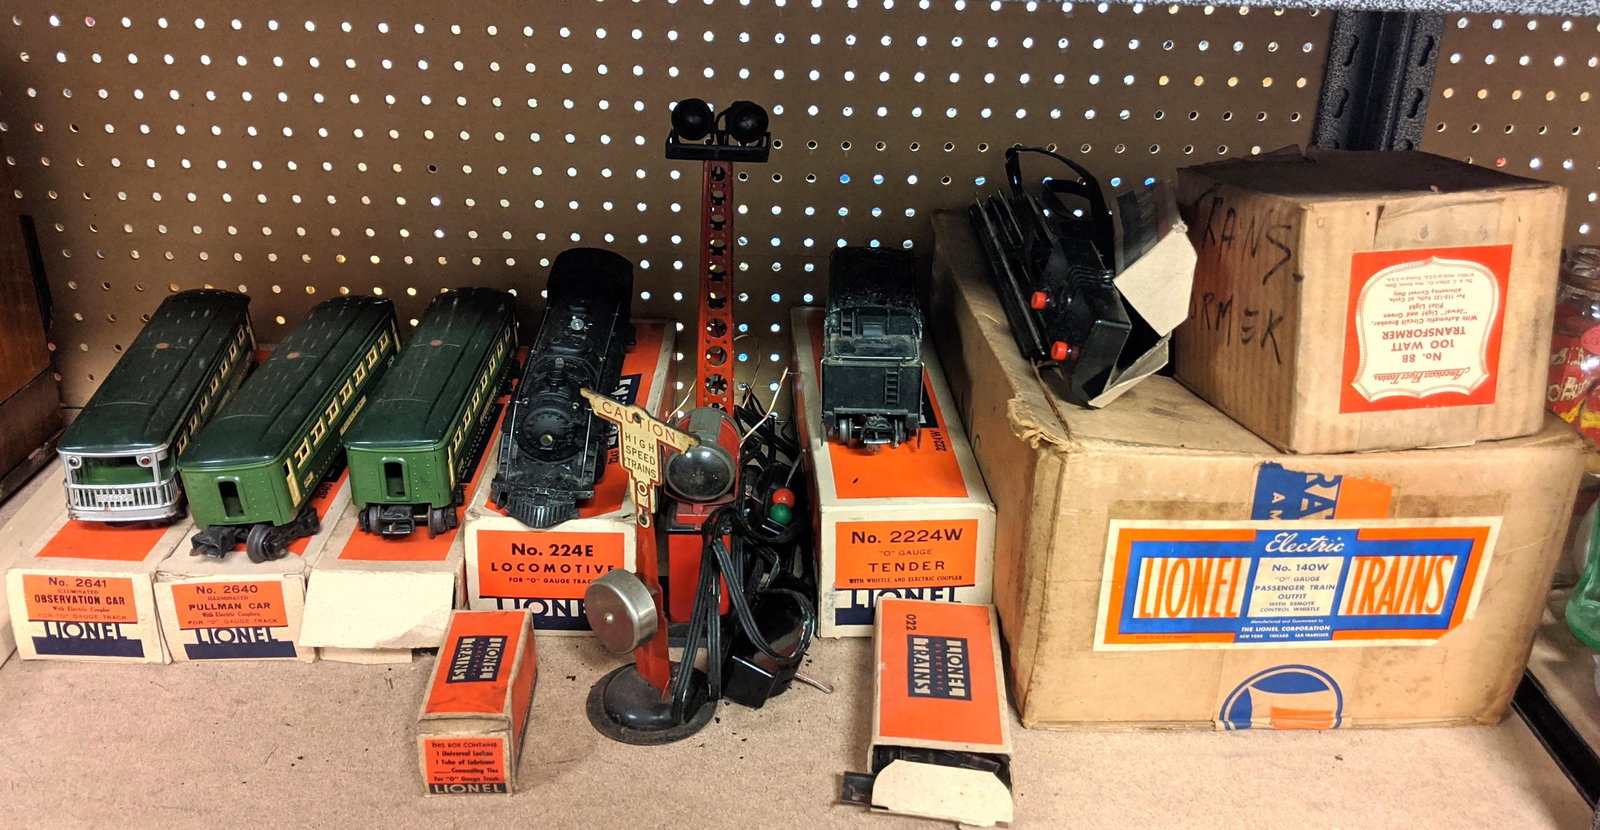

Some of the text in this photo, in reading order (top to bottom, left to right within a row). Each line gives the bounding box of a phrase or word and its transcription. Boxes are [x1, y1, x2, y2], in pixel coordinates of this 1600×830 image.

[1441, 308, 1468, 316] "Jewel"
[1402, 317, 1424, 325] Circuit
[1426, 316, 1460, 324] Automatic
[1382, 326, 1466, 340] TRANSFORMER
[1391, 339, 1454, 352] 100 WATT
[1402, 352, 1442, 363] No. 8B
[1373, 367, 1470, 384] American Flyer Trains
[602, 401, 676, 444] CAUTION
[624, 432, 655, 454] HIGH
[625, 445, 656, 466] SPEED
[624, 458, 656, 479] TRAINS
[852, 528, 964, 544] No. 2224W
[1265, 532, 1345, 553] Electric
[511, 542, 594, 557] No. 224E
[490, 562, 614, 574] LOCOMOTIVE
[868, 560, 945, 573] TENDER
[1272, 563, 1329, 572] No. 140W
[48, 577, 107, 588] No. 2641
[196, 584, 258, 595] No. 2640
[1138, 557, 1243, 618] LIONEL
[1345, 556, 1454, 615] TRAINS
[34, 594, 125, 606] OBSERVATION CAR
[188, 602, 271, 611] PULLMAN CAR
[44, 621, 128, 640] LIONEL
[195, 627, 278, 644] LIONEL
[452, 638, 476, 680] TRAINS
[479, 638, 503, 679] LIONEL
[913, 637, 931, 694] TRAINS
[946, 640, 966, 697] LIONEL
[434, 784, 502, 794] LIONEL
